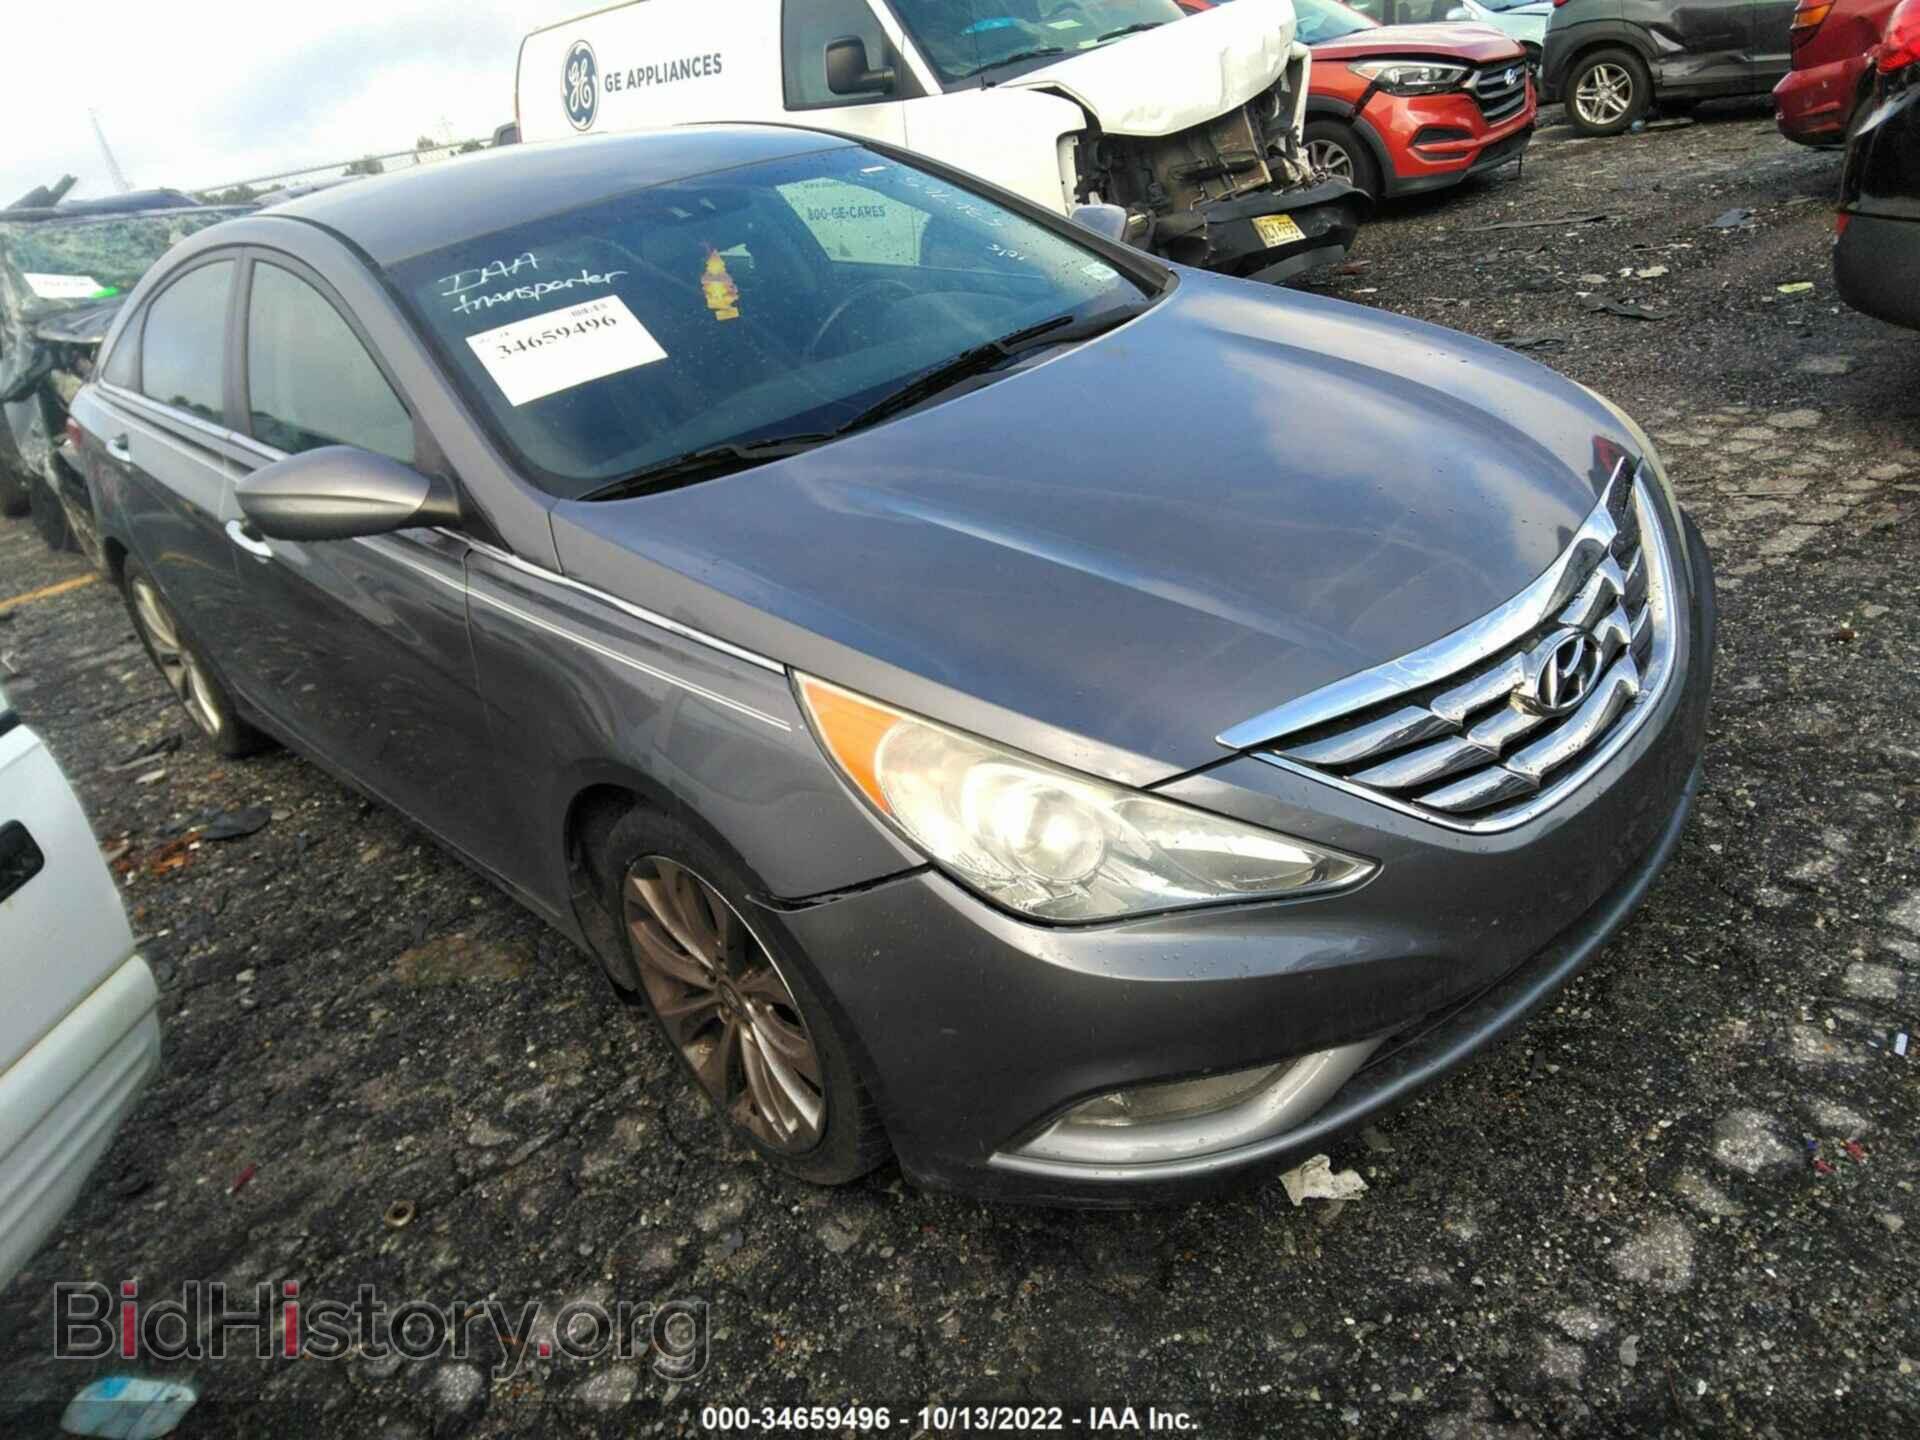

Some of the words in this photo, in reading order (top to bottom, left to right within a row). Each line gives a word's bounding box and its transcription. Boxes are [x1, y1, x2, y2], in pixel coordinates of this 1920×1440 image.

[604, 72, 622, 93] GE
[626, 52, 722, 89] APPLIANCES
[497, 314, 618, 359] 34659496
